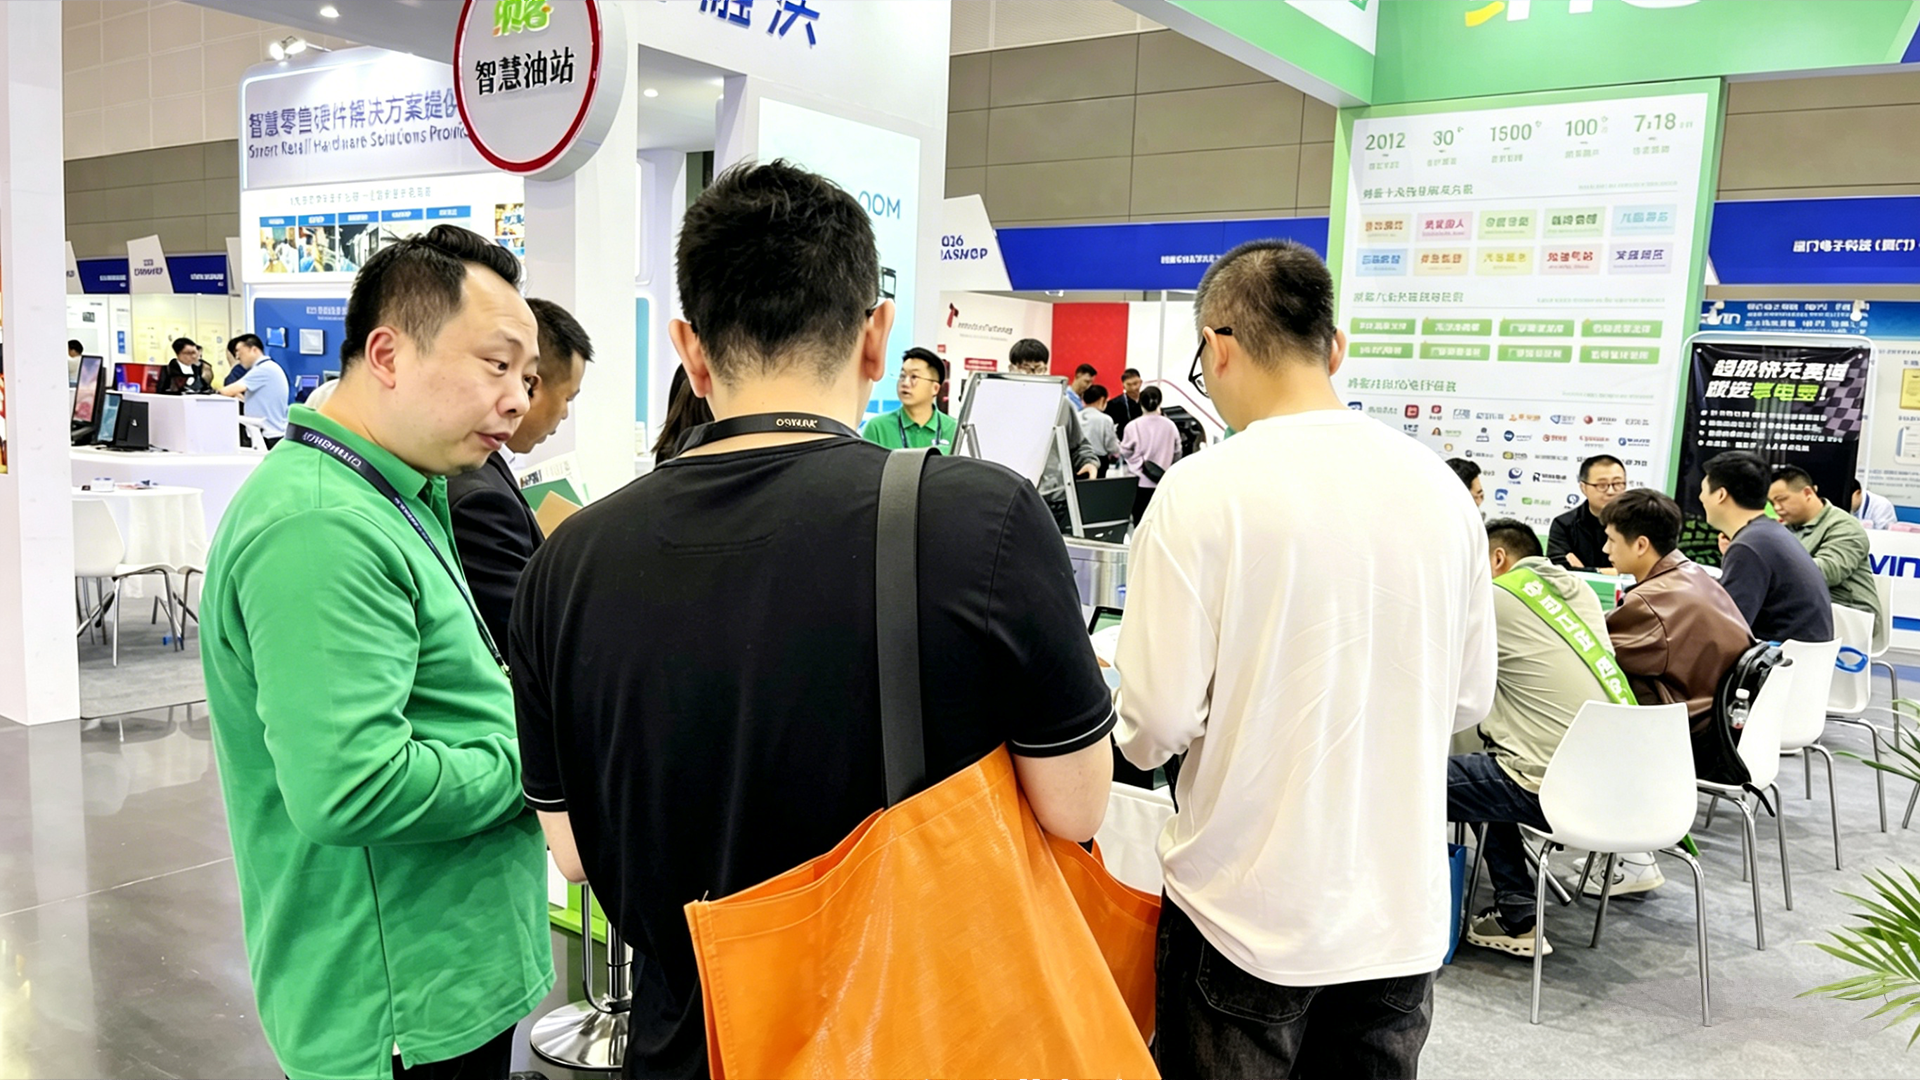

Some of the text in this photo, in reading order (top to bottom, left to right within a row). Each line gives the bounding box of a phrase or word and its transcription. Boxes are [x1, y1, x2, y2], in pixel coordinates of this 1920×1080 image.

[475, 46, 575, 96] 智慧油站
[1565, 118, 1598, 137] 100
[1365, 132, 1406, 151] 2012
[1433, 130, 1454, 146] 30
